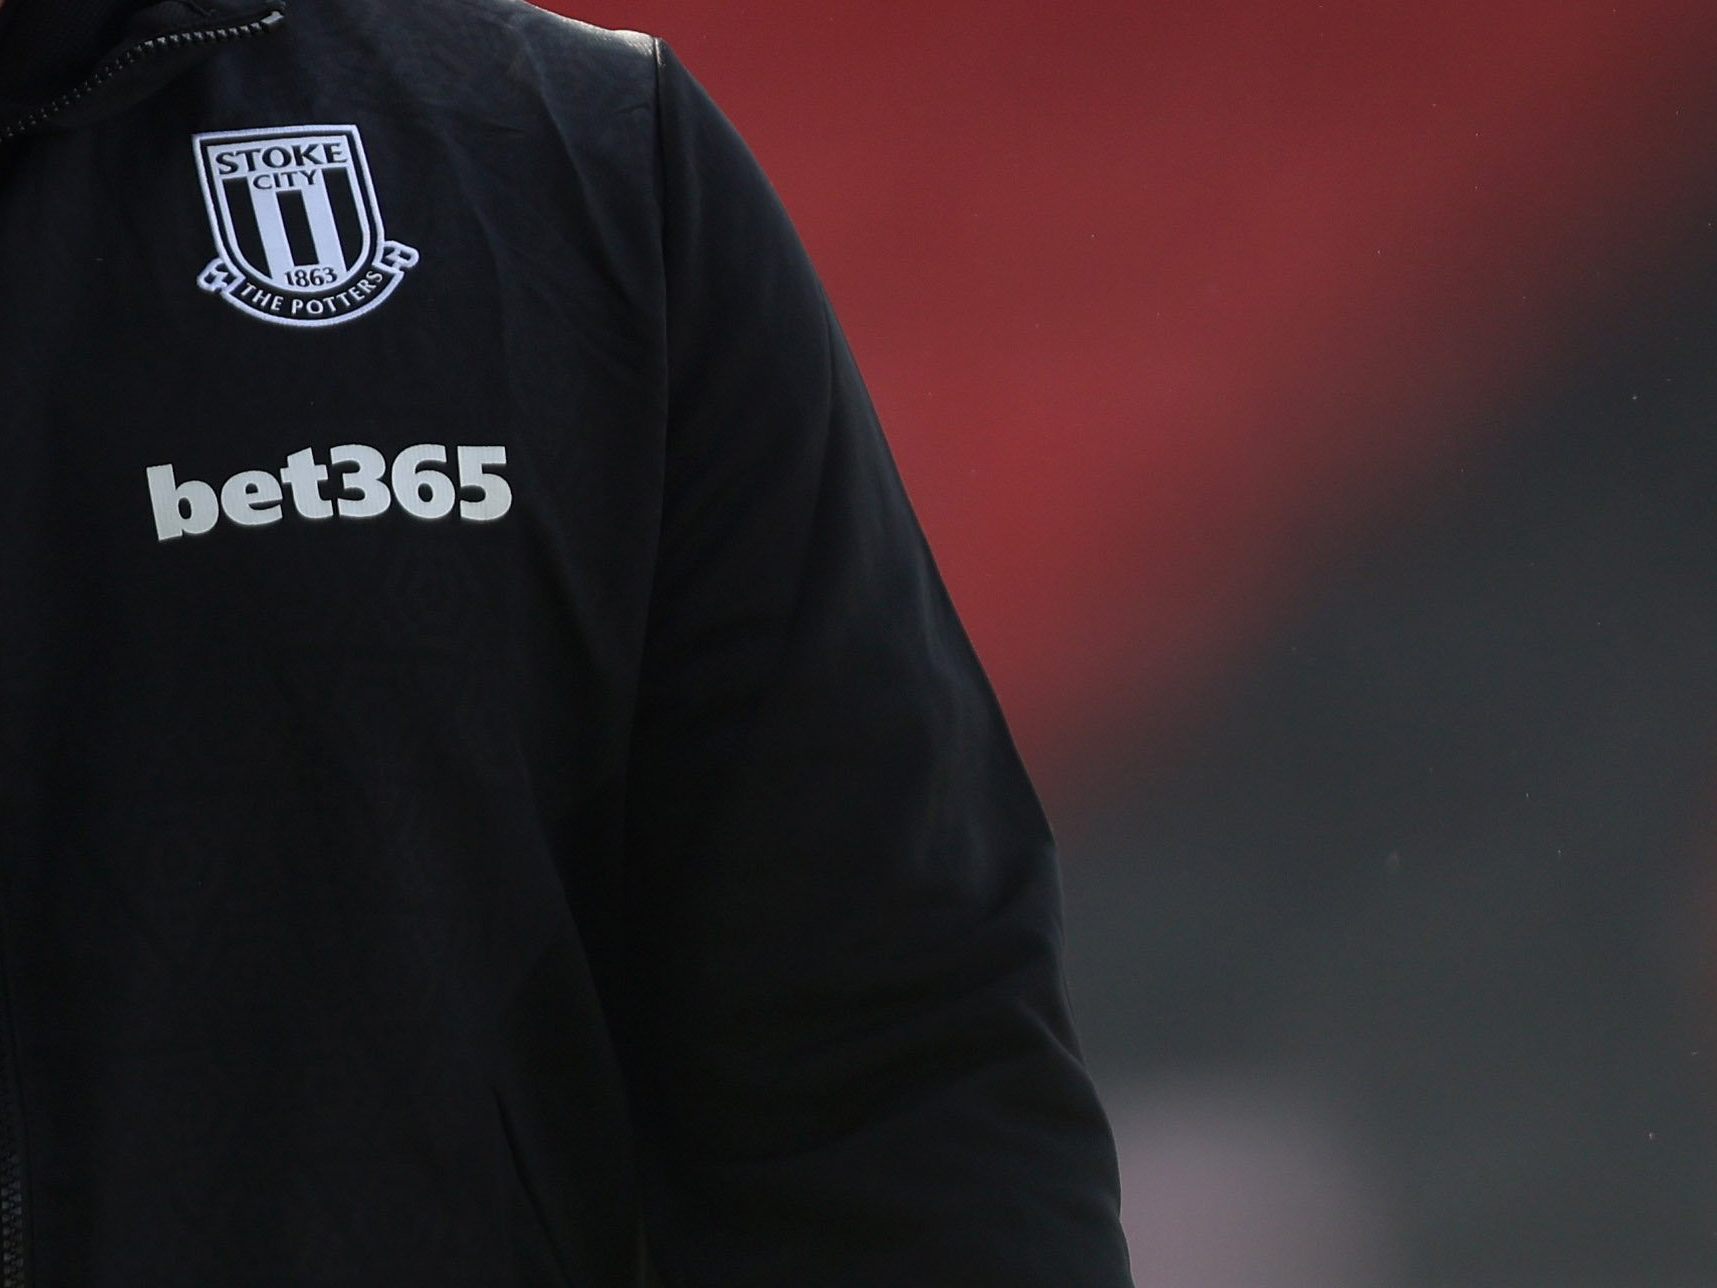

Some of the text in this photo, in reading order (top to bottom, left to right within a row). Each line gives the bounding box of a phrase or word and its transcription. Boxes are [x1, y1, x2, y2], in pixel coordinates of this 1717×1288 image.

[215, 142, 349, 175] STOKE
[252, 169, 318, 190] CITY
[239, 269, 384, 315] THE POTTERS
[284, 267, 338, 288] 1863
[146, 443, 513, 541] bet365
